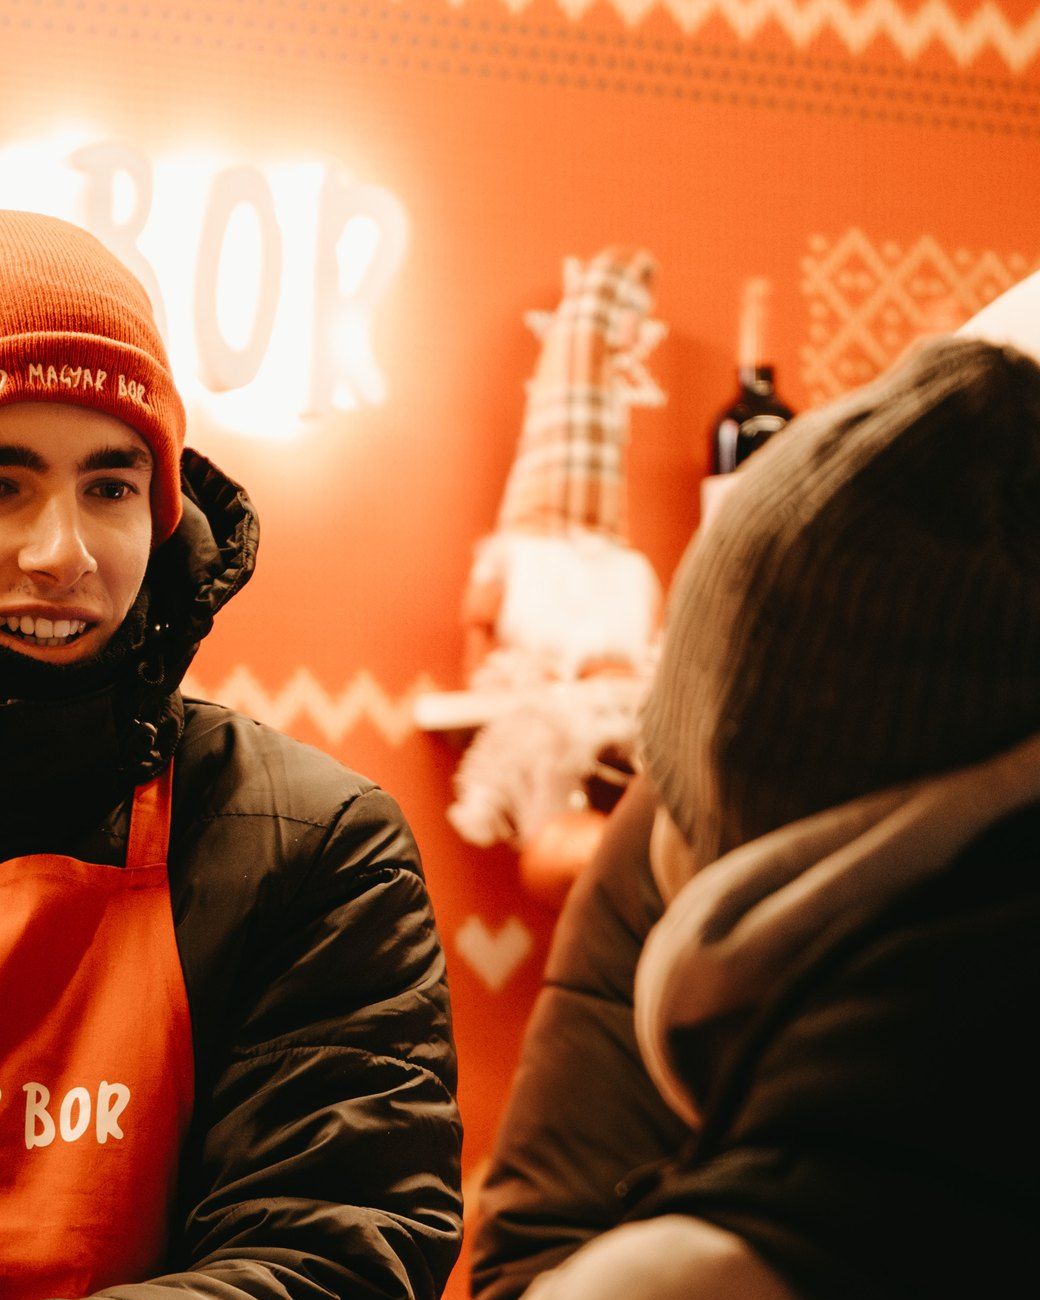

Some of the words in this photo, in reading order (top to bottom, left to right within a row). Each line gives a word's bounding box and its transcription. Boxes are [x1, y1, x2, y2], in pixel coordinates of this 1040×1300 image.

[27, 362, 108, 392] MAGYAR
[117, 373, 147, 405] BOR
[22, 1080, 131, 1150] BOR
